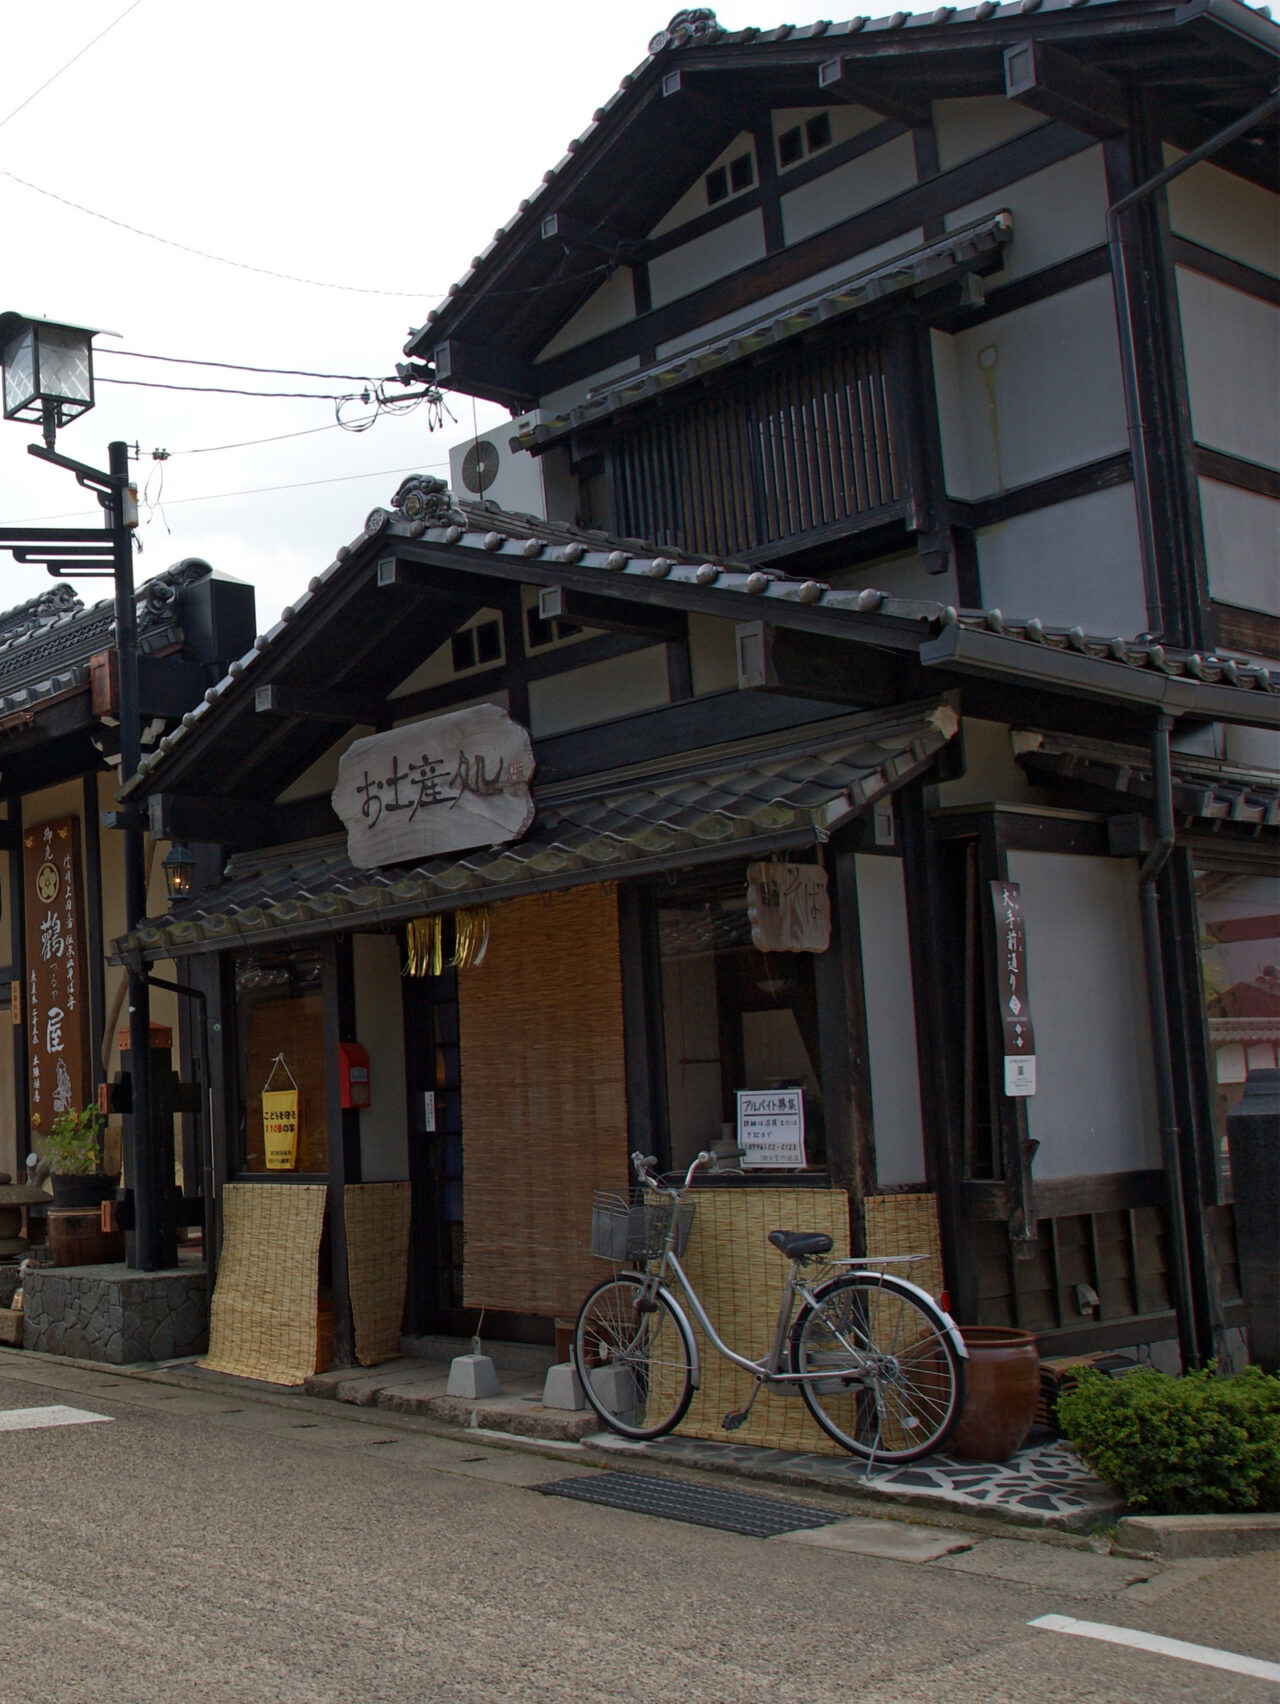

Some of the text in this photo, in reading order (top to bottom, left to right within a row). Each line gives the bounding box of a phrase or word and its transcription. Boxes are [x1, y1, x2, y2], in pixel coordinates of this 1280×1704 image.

[1001, 888, 1021, 991] 大手前通り
